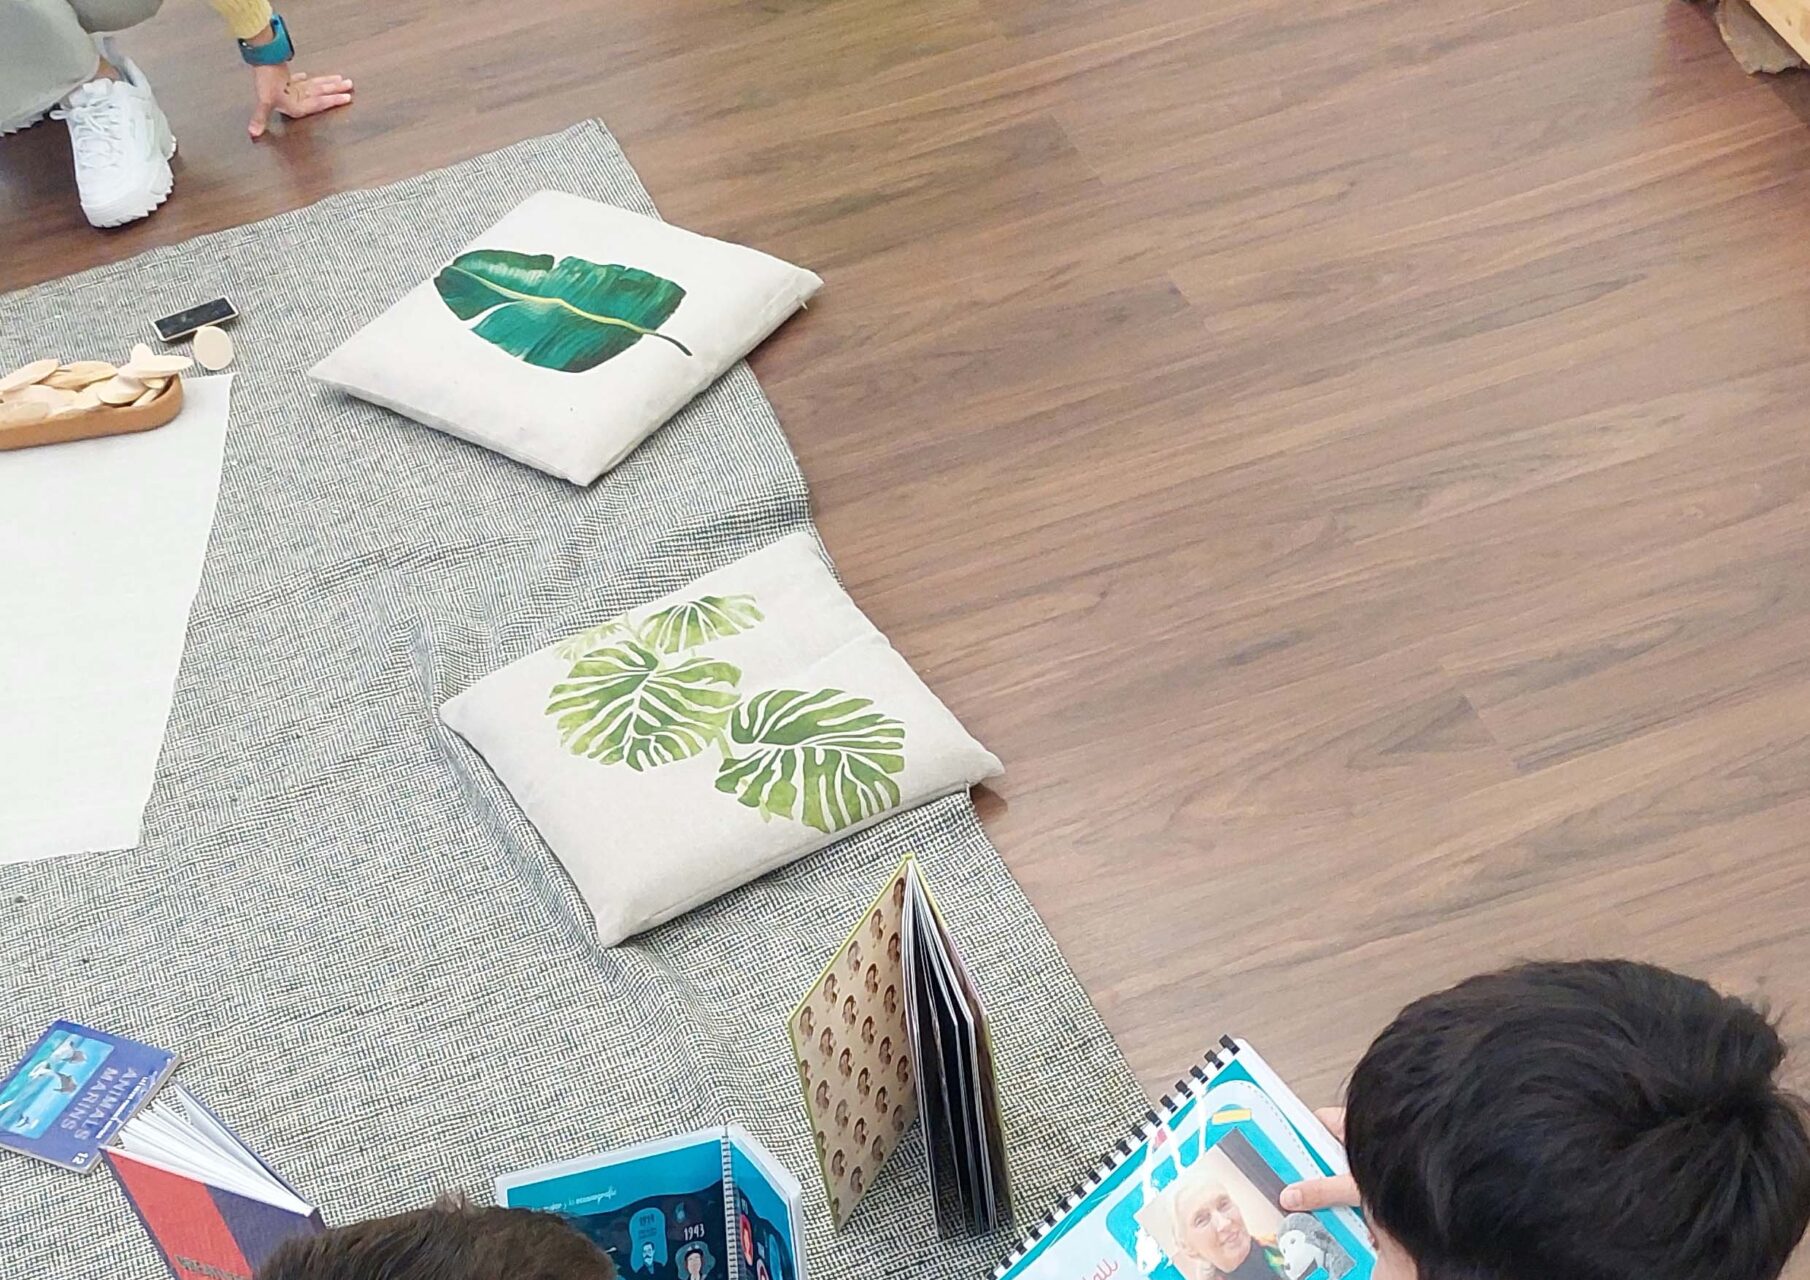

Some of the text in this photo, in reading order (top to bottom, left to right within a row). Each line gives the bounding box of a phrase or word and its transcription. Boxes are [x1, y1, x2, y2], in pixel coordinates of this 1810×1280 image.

[60, 1066, 118, 1132] MARINS
[73, 1066, 138, 1141] ANIMALS
[71, 1149, 88, 1166] 12
[683, 1223, 705, 1239] 1943
